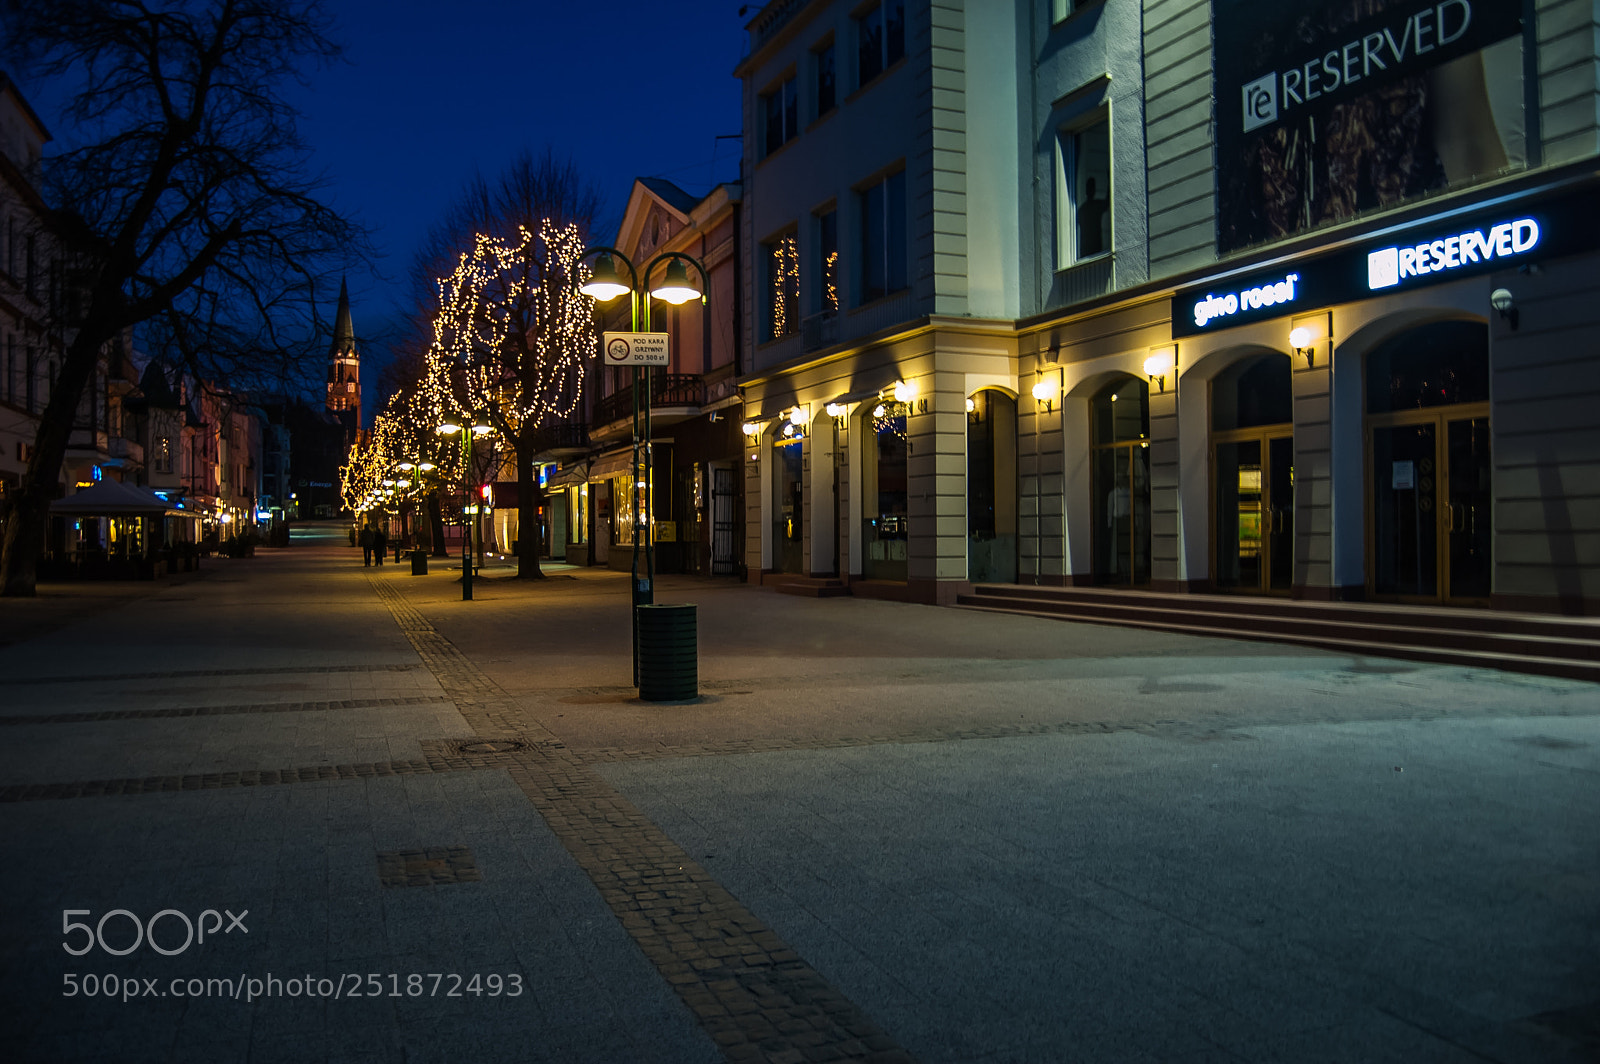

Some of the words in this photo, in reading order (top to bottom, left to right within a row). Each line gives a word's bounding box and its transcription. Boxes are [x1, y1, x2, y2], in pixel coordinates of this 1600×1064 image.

[1281, 0, 1472, 110] RESERVED
[1398, 218, 1540, 278] RESERVED
[1194, 294, 1238, 327] gino
